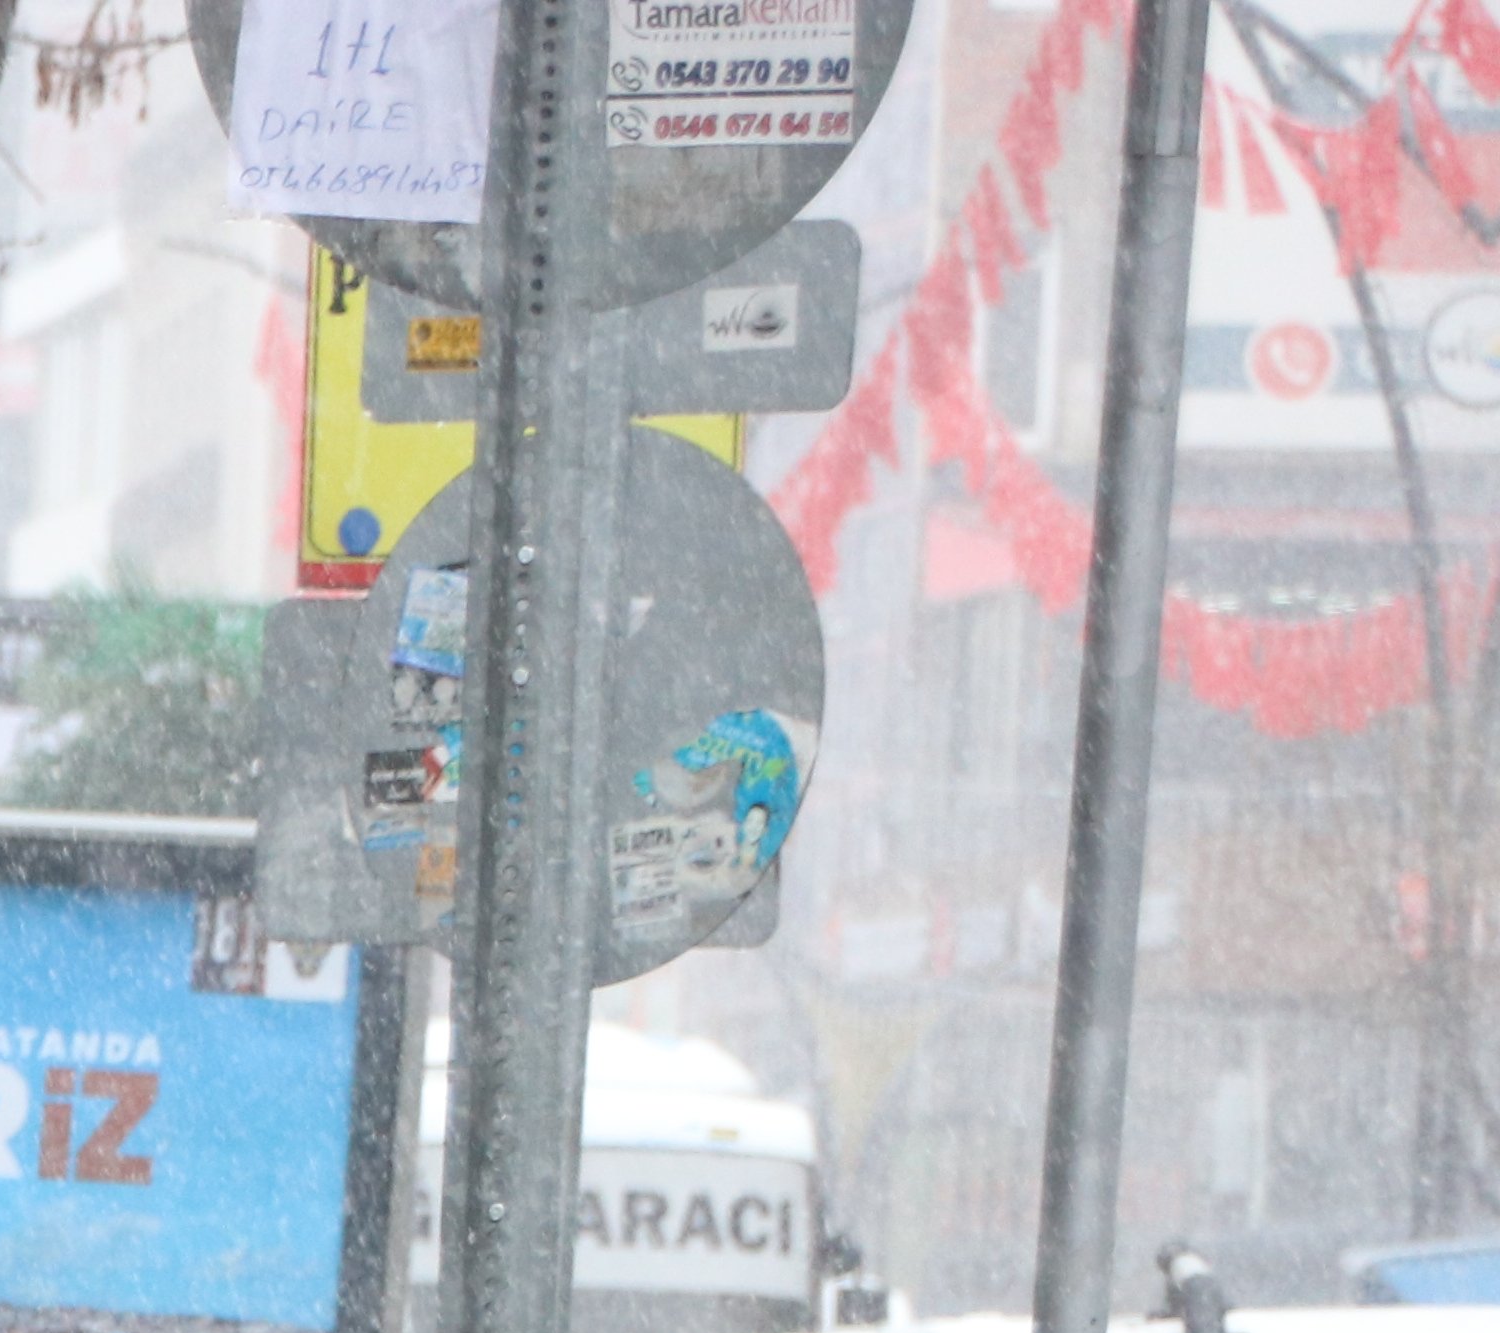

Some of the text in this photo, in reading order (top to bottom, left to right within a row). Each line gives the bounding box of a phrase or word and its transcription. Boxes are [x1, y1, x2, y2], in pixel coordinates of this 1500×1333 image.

[655, 56, 850, 89] 0543 370 29 90
